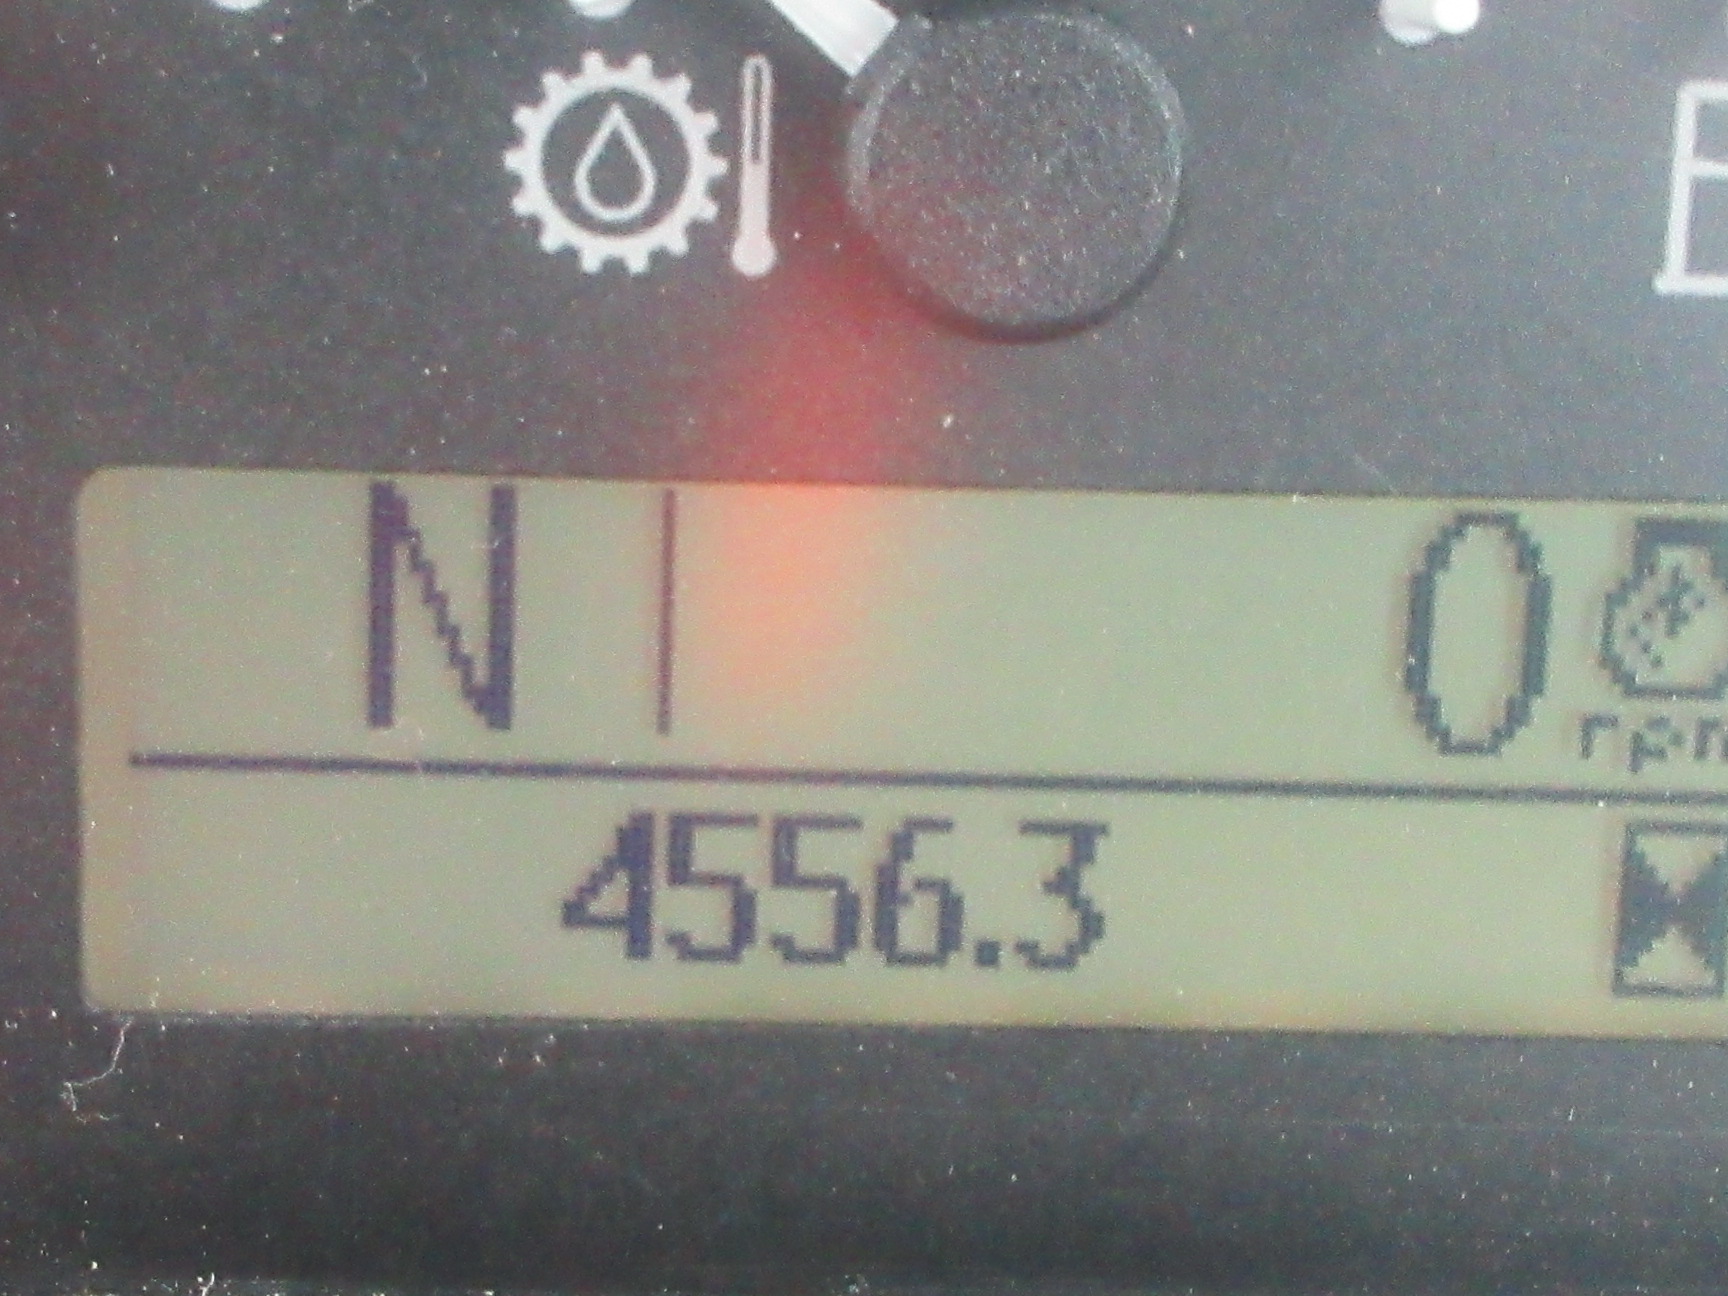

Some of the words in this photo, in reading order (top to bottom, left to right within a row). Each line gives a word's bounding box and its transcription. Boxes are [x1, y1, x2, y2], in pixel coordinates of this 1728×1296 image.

[367, 480, 517, 730] N
[1403, 510, 1553, 756] 0
[562, 811, 1110, 969] 4556.3
